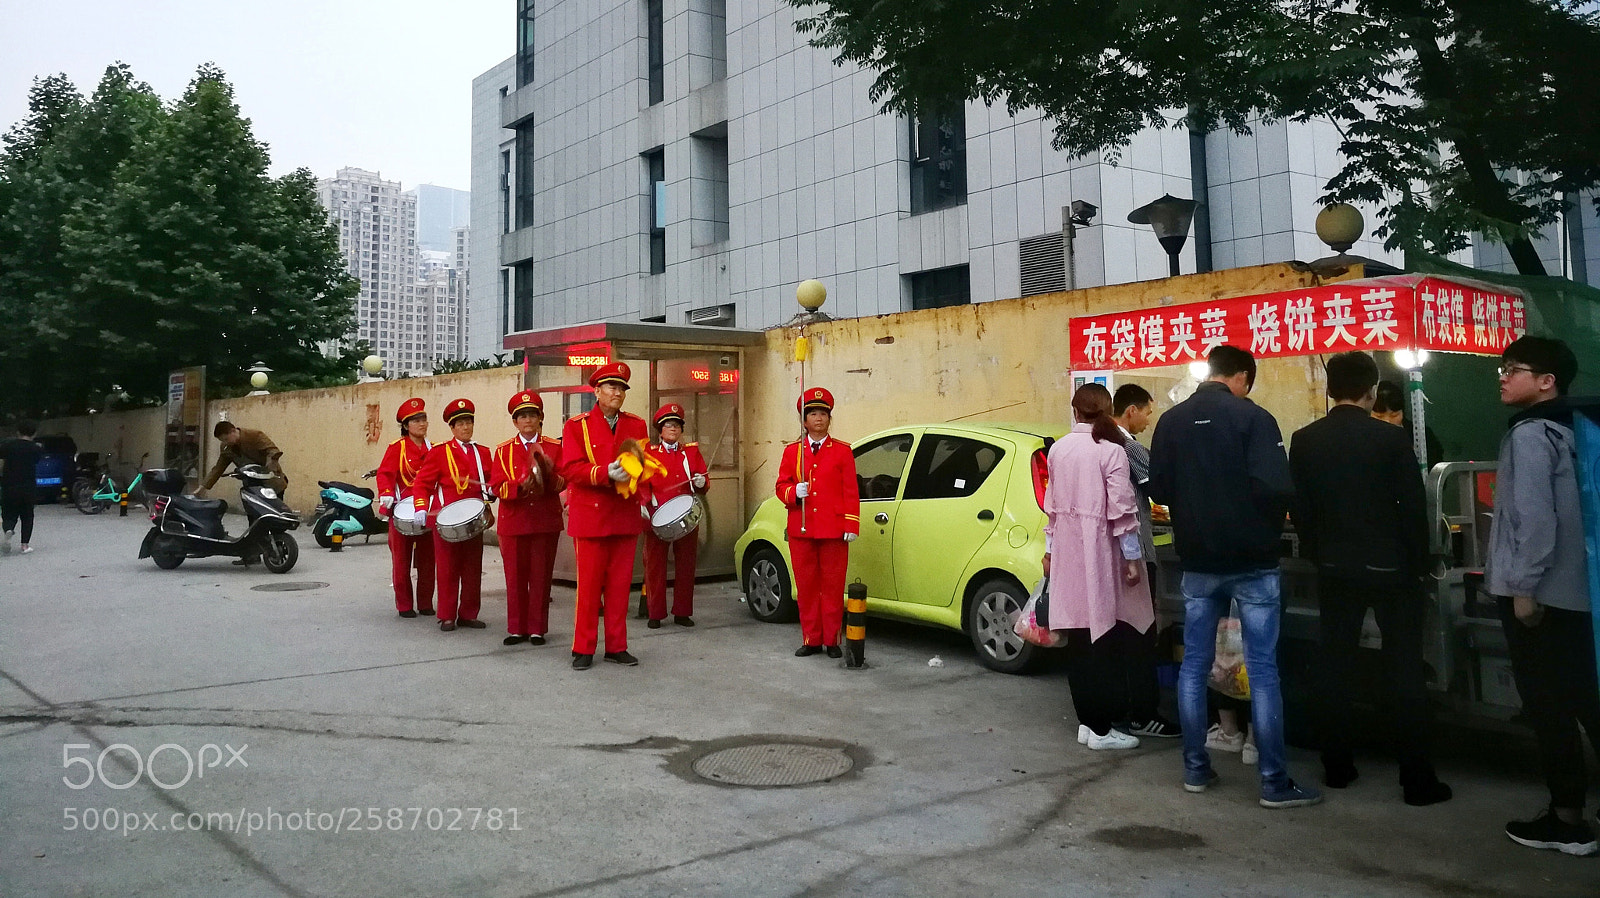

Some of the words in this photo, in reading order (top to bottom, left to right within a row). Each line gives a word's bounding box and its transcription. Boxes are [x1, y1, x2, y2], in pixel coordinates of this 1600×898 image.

[1083, 308, 1229, 368] 布袋馍夹菜
[1247, 288, 1400, 354] 烧饼夹菜
[1421, 285, 1467, 346] 布袋馍
[1472, 292, 1526, 349] 烧饼夹菜
